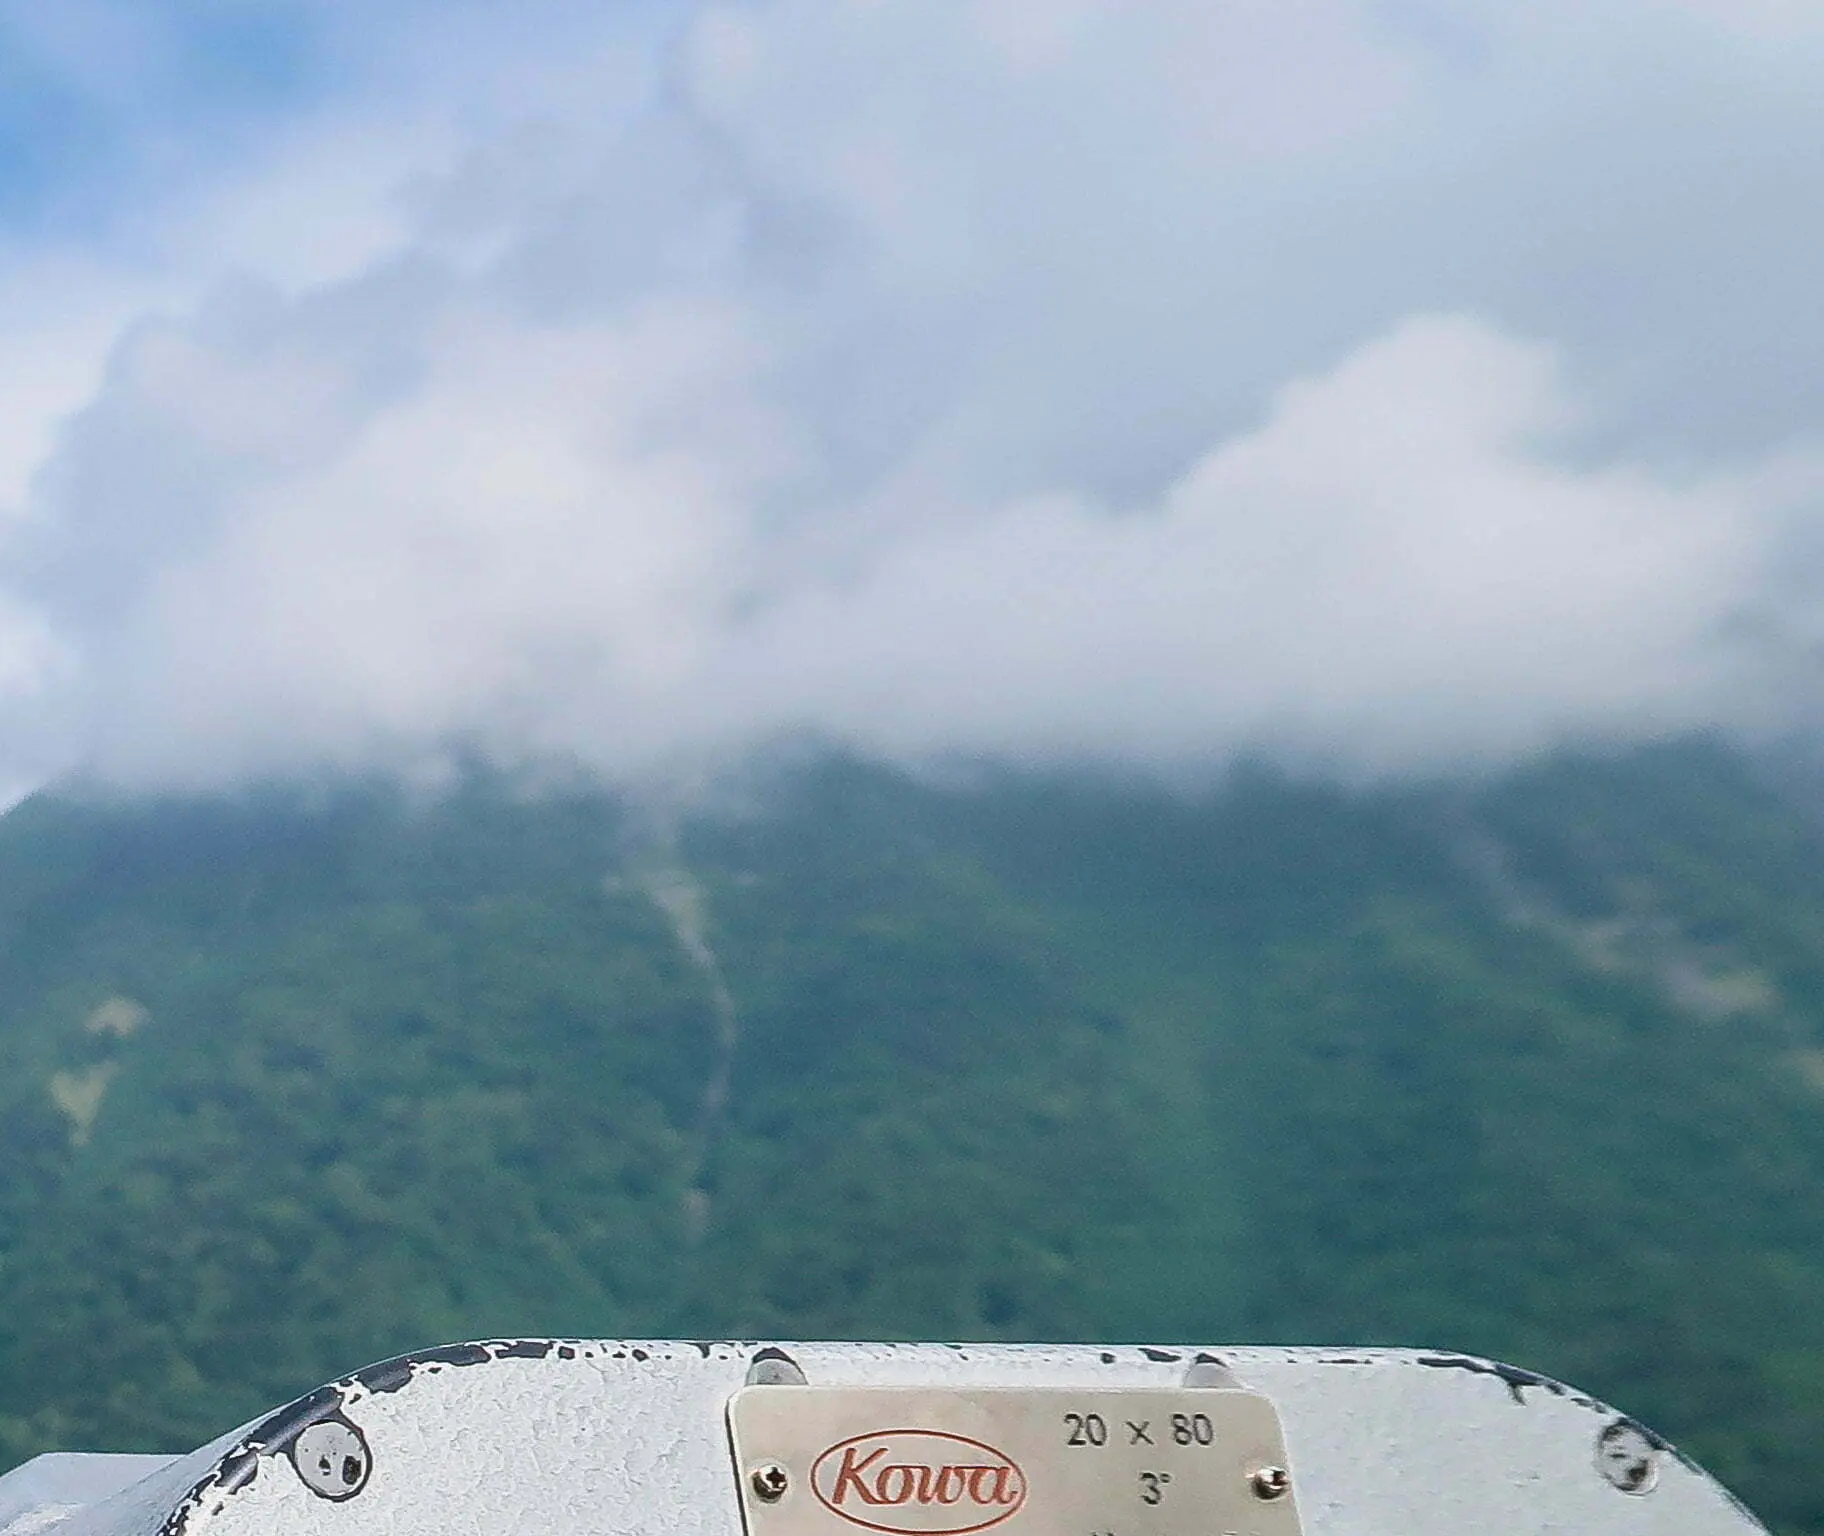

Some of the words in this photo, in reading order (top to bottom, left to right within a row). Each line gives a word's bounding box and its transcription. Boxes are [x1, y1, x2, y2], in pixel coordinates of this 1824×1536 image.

[1064, 1413, 1108, 1446] 20
[1172, 1413, 1214, 1446] 80
[832, 1447, 1019, 1505] Kowa
